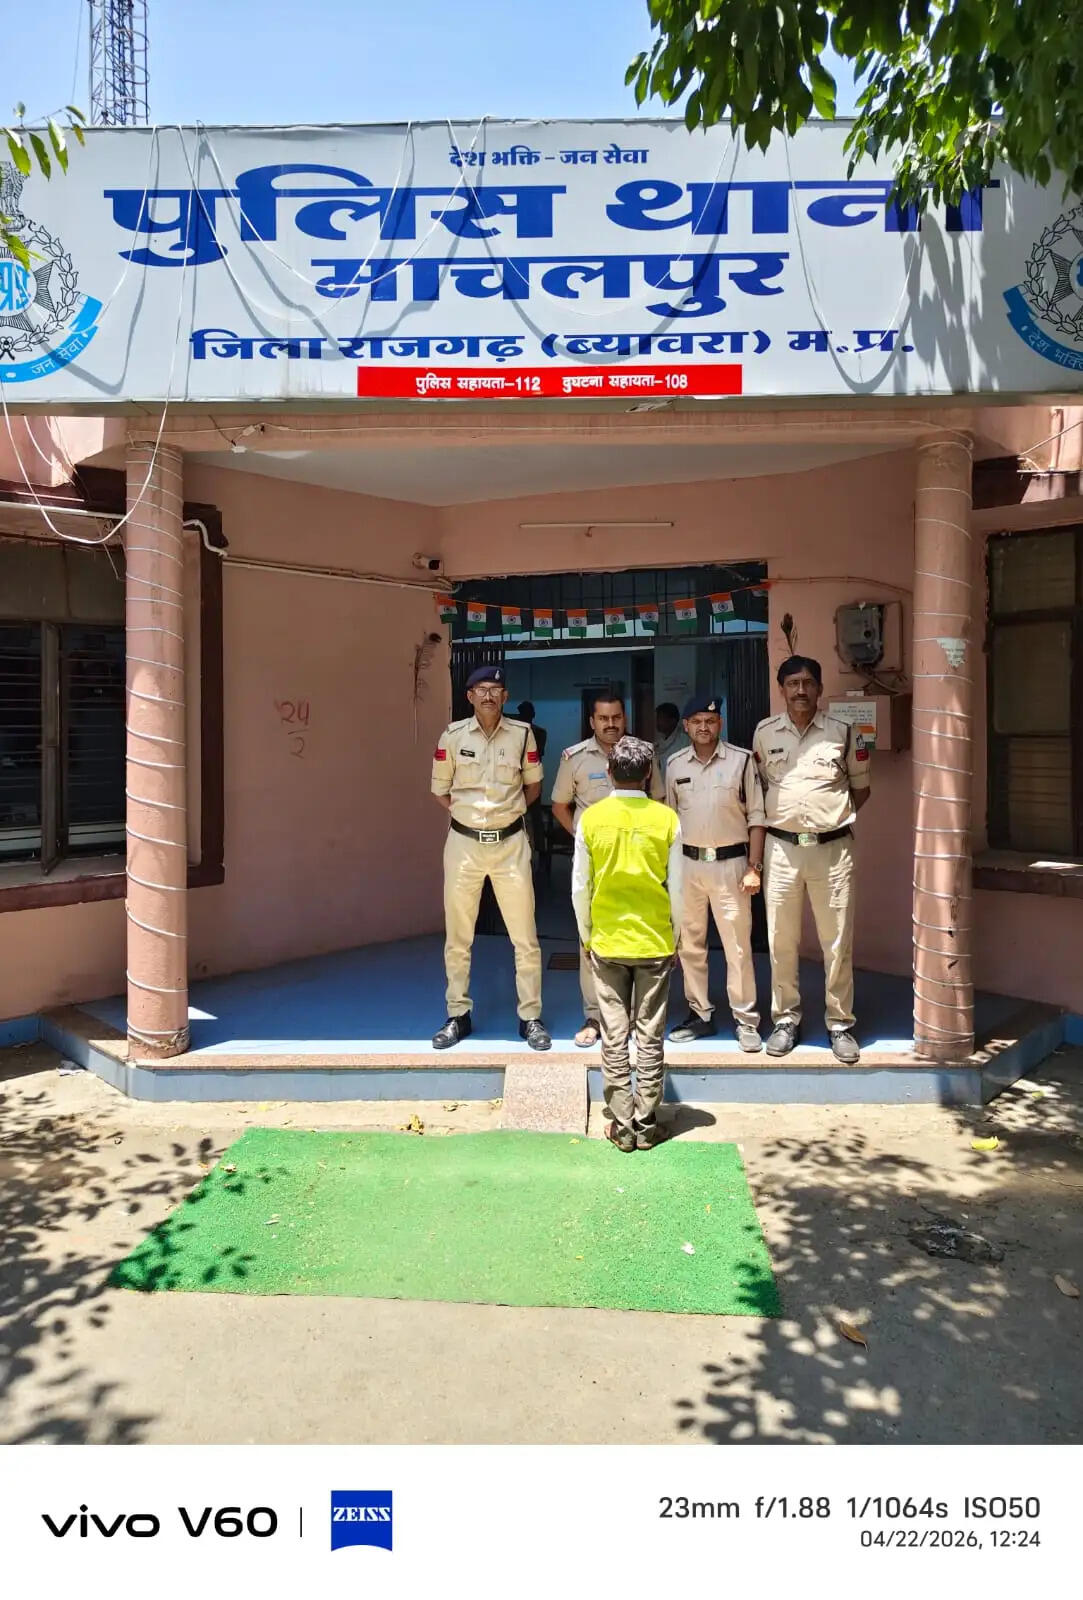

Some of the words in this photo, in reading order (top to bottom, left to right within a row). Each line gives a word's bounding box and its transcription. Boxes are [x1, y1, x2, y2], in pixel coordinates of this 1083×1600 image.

[449, 145, 485, 167] देश
[492, 144, 541, 165] भक्ति
[559, 150, 598, 165] जन
[603, 143, 649, 164] सेवा
[104, 164, 566, 267] पुलिस
[606, 180, 1000, 235] थाना
[311, 252, 789, 318] माचलपुर
[189, 328, 327, 360] जिला
[336, 336, 525, 362] राजगढ़
[541, 329, 772, 358] (ब्यावरा)
[416, 372, 452, 394] पुलिस
